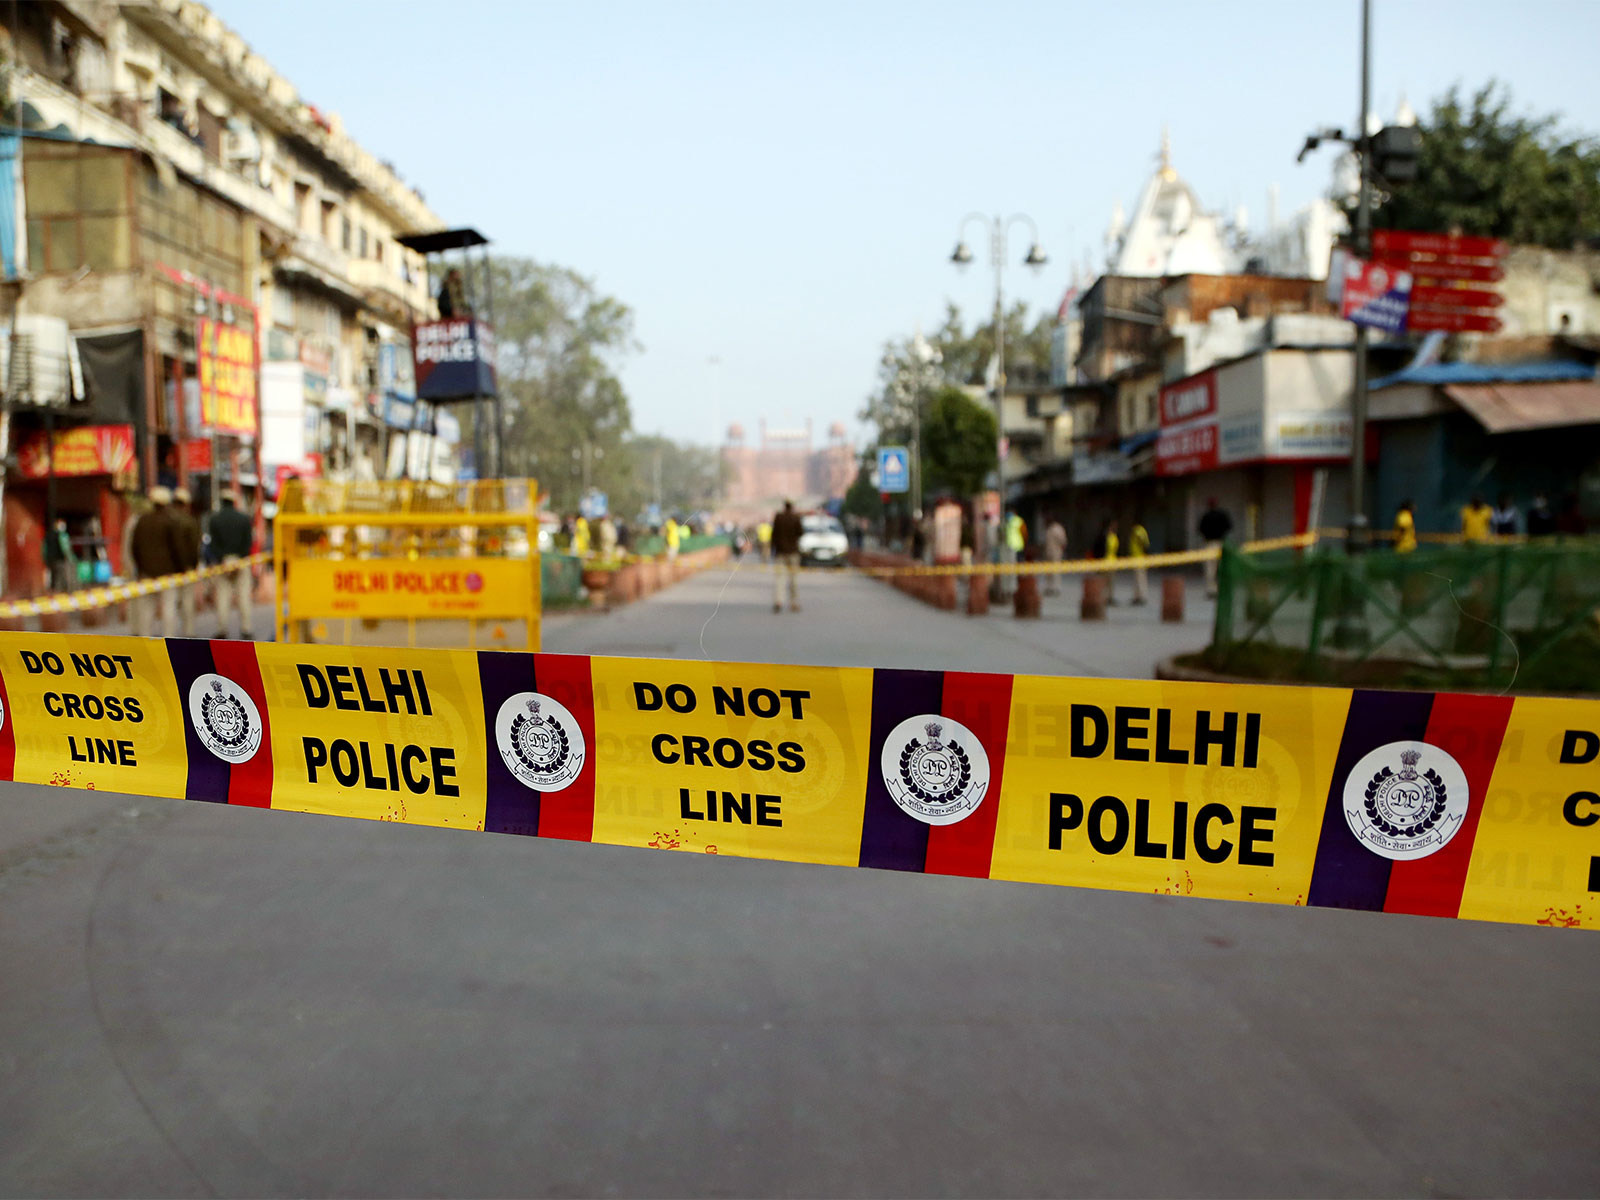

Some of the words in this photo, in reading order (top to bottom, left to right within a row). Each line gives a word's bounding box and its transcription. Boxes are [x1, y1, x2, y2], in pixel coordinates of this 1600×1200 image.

[334, 571, 388, 593] DELHI
[393, 572, 459, 594] POLICE
[19, 650, 65, 676] DO
[73, 653, 134, 680] NOT
[43, 691, 144, 723] CROSS
[295, 663, 433, 716] DELHI
[633, 681, 697, 714] DO
[712, 686, 811, 720] NOT
[67, 735, 137, 767] LINE
[651, 733, 806, 773] CROSS
[1070, 703, 1261, 769] DELHI
[302, 736, 460, 798] POLICE
[1380, 777, 1397, 799] POLICE
[679, 788, 783, 828] LINE
[1048, 792, 1277, 867] POLICE
